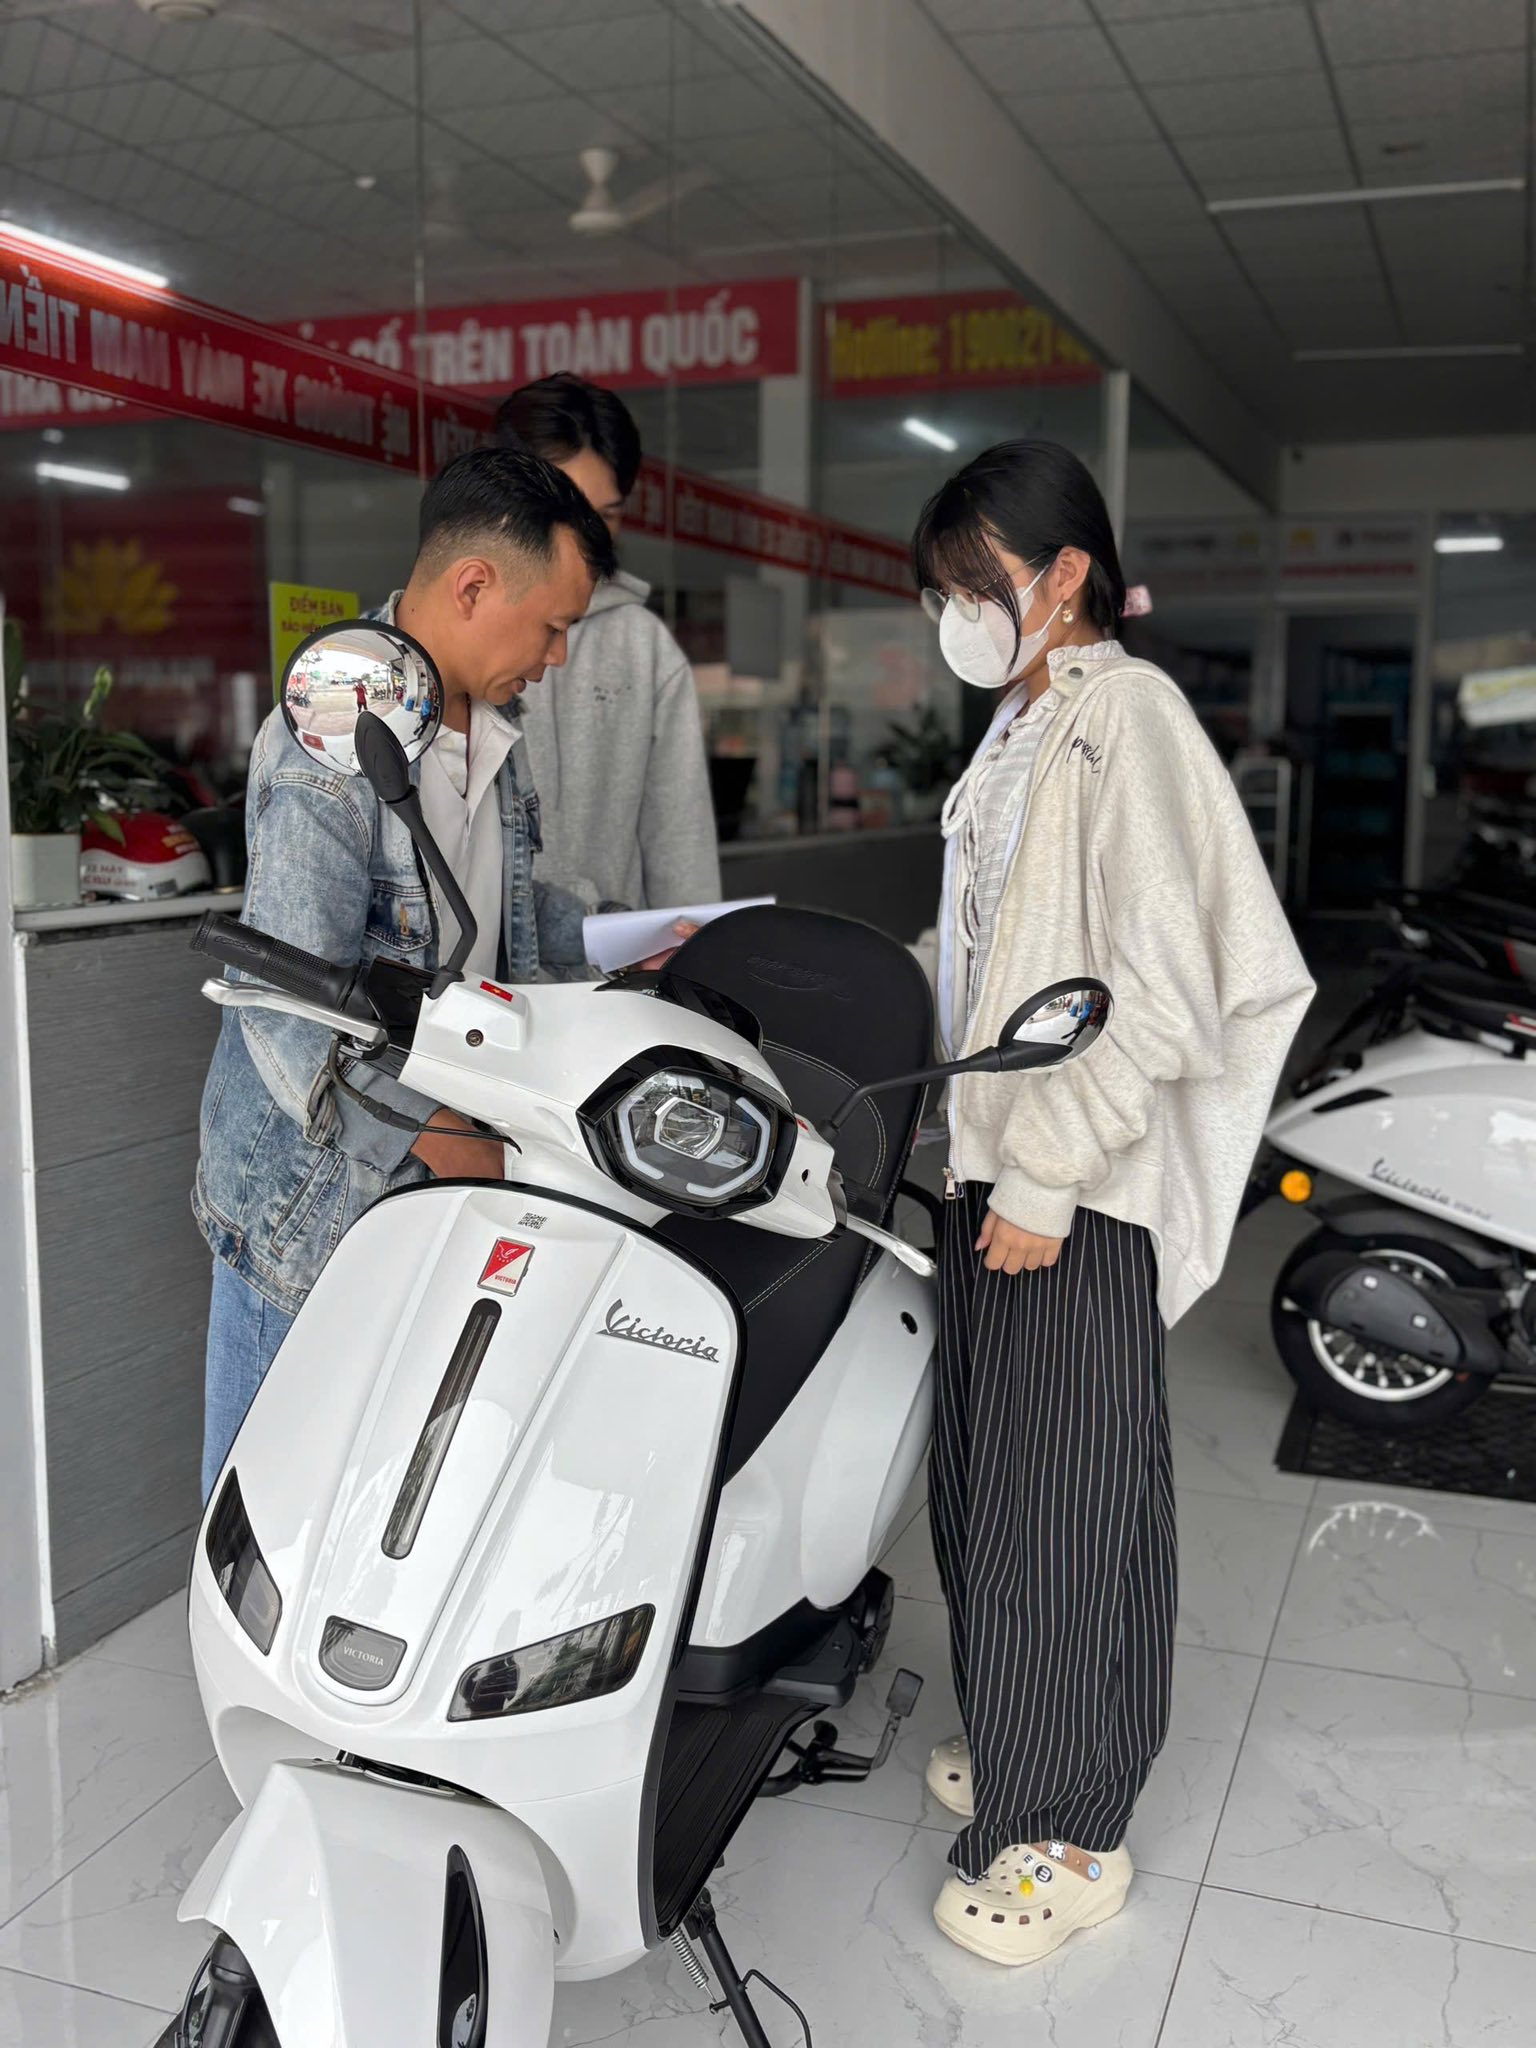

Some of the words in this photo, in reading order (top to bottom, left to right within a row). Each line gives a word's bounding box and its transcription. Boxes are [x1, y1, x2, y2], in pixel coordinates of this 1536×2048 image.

[409, 318, 513, 386] TRÊN
[521, 307, 632, 377] TOÀN
[642, 288, 760, 373] QUỐC
[494, 1274, 517, 1285] VICTORIA
[597, 1298, 720, 1362] Victoria
[343, 1646, 384, 1666] VICTORIA
